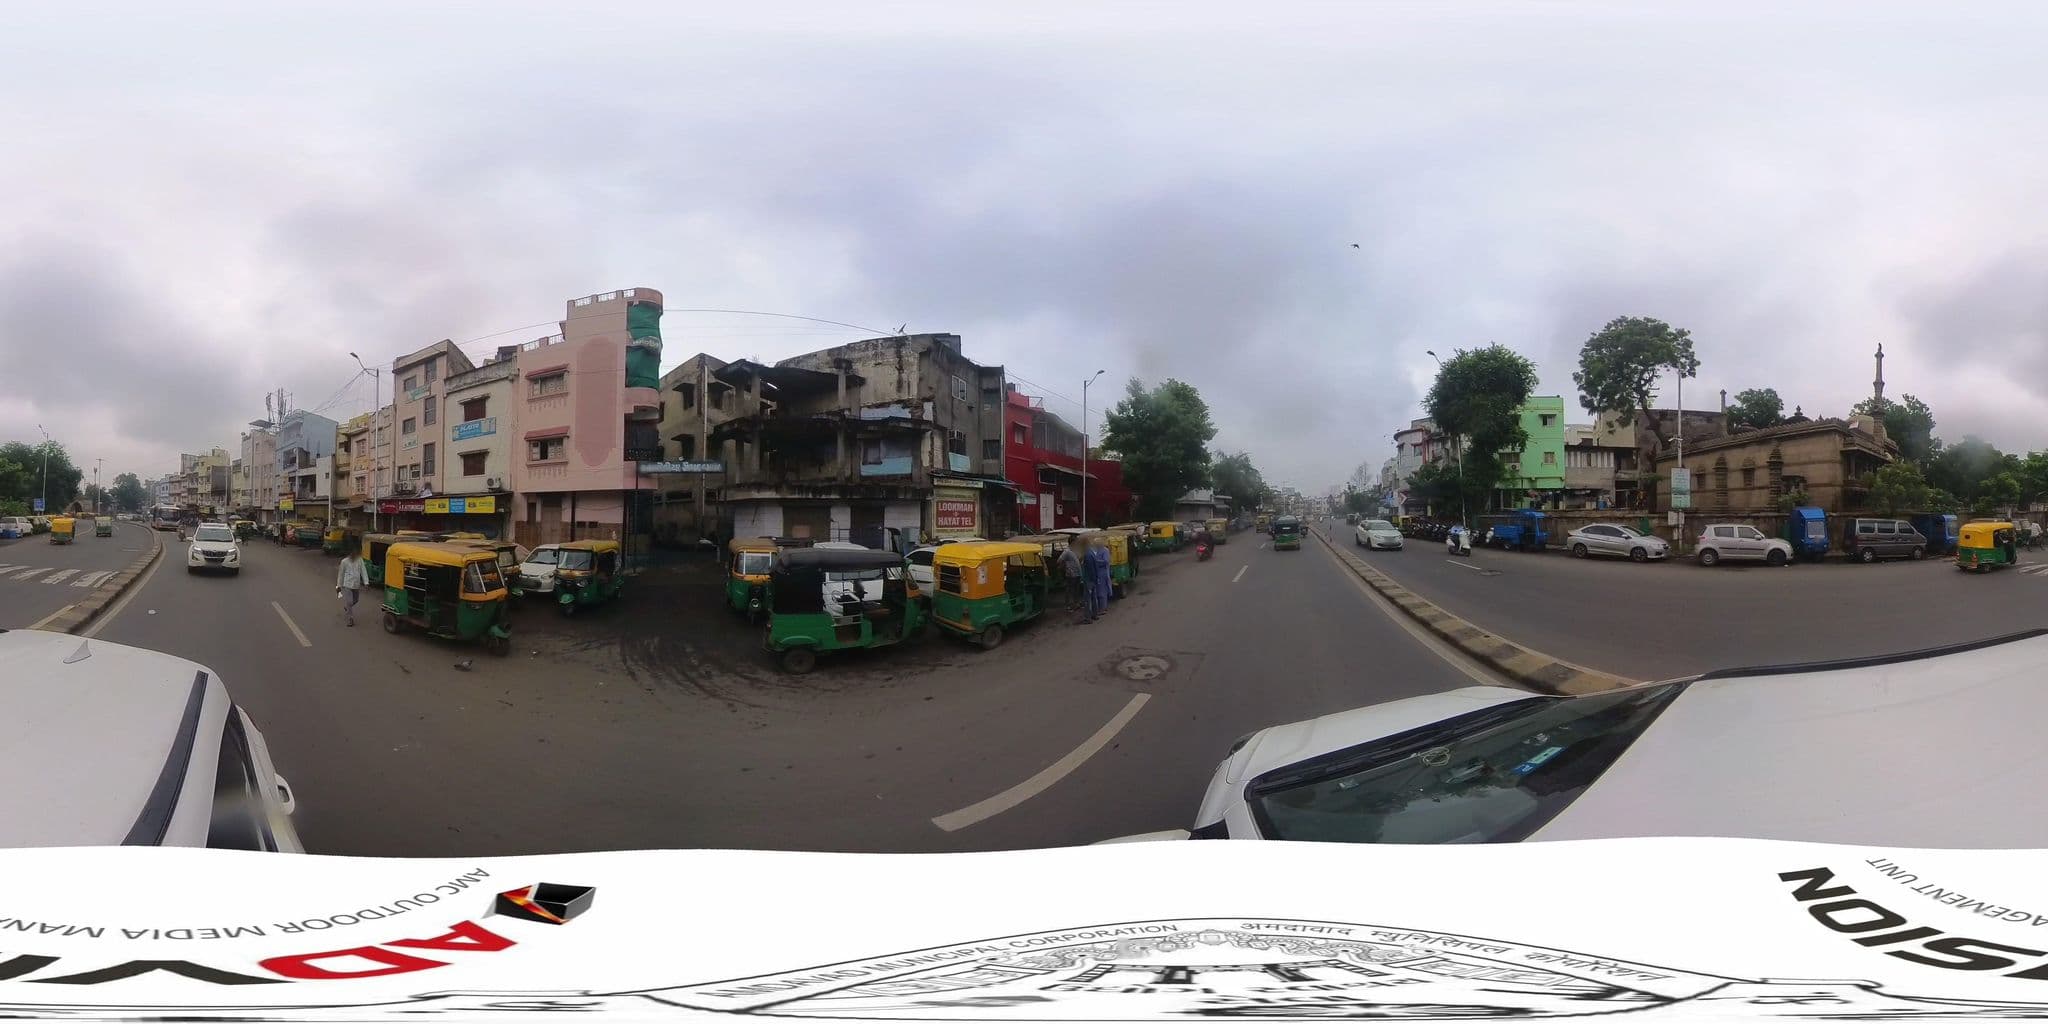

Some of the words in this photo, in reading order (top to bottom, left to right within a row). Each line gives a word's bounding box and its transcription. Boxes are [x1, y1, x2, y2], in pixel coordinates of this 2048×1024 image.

[938, 502, 973, 512] LOOKMAN
[938, 516, 960, 526] HAYAT
[961, 517, 973, 526] TEL
